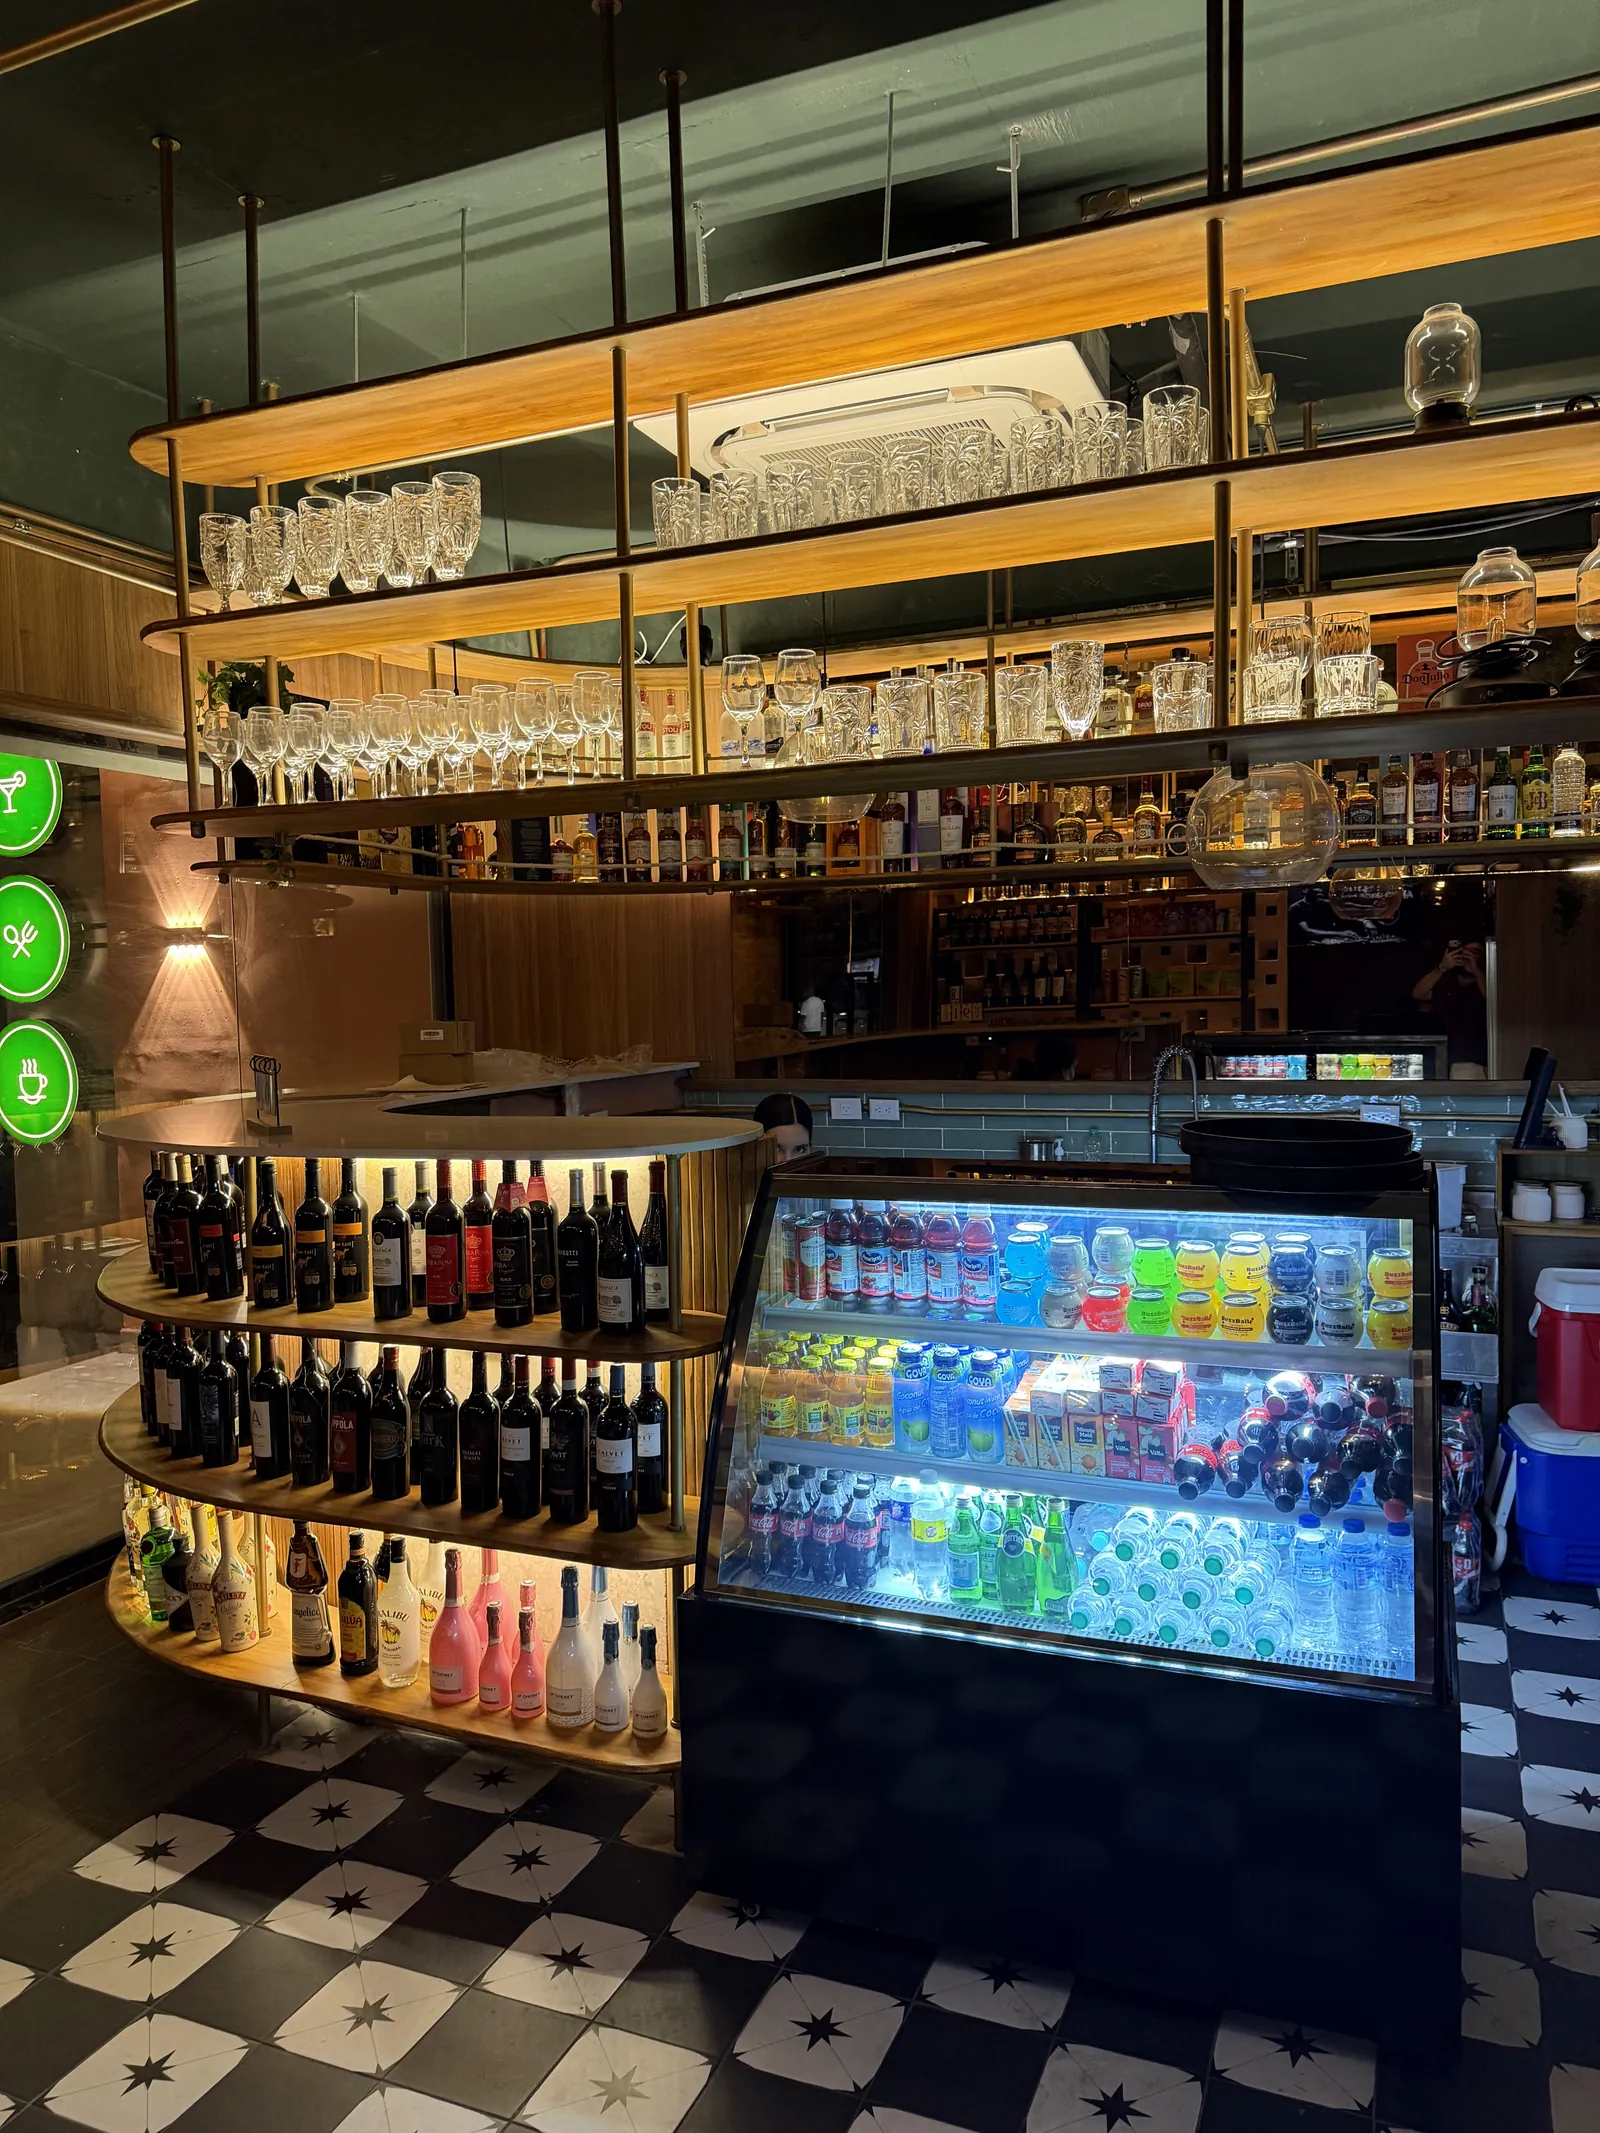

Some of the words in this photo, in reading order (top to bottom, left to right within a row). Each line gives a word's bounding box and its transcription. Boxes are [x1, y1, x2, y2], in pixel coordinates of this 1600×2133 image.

[1402, 674, 1425, 684] Don
[1421, 671, 1450, 686] Julio
[639, 724, 653, 732] TOLI
[662, 725, 680, 734] STOLI
[1526, 791, 1548, 811] J&B
[1221, 1316, 1254, 1325] BuzzBallz
[1321, 1321, 1354, 1330] BuzzBallz
[906, 1366, 927, 1379] GOYA
[968, 1376, 992, 1387] GOYA
[897, 1387, 926, 1401] Coconut
[967, 1398, 984, 1406] onut
[912, 1404, 921, 1412] de
[980, 1406, 1002, 1418] Coco
[251, 1408, 262, 1426] A
[291, 1415, 312, 1424] PPOLA
[332, 1418, 354, 1430] PPOLA
[1076, 1426, 1096, 1434] Minute
[550, 1451, 568, 1459] AVIT
[293, 1558, 302, 1574] F
[188, 1583, 212, 1592] AILEYS
[419, 1588, 443, 1601] ALIBU
